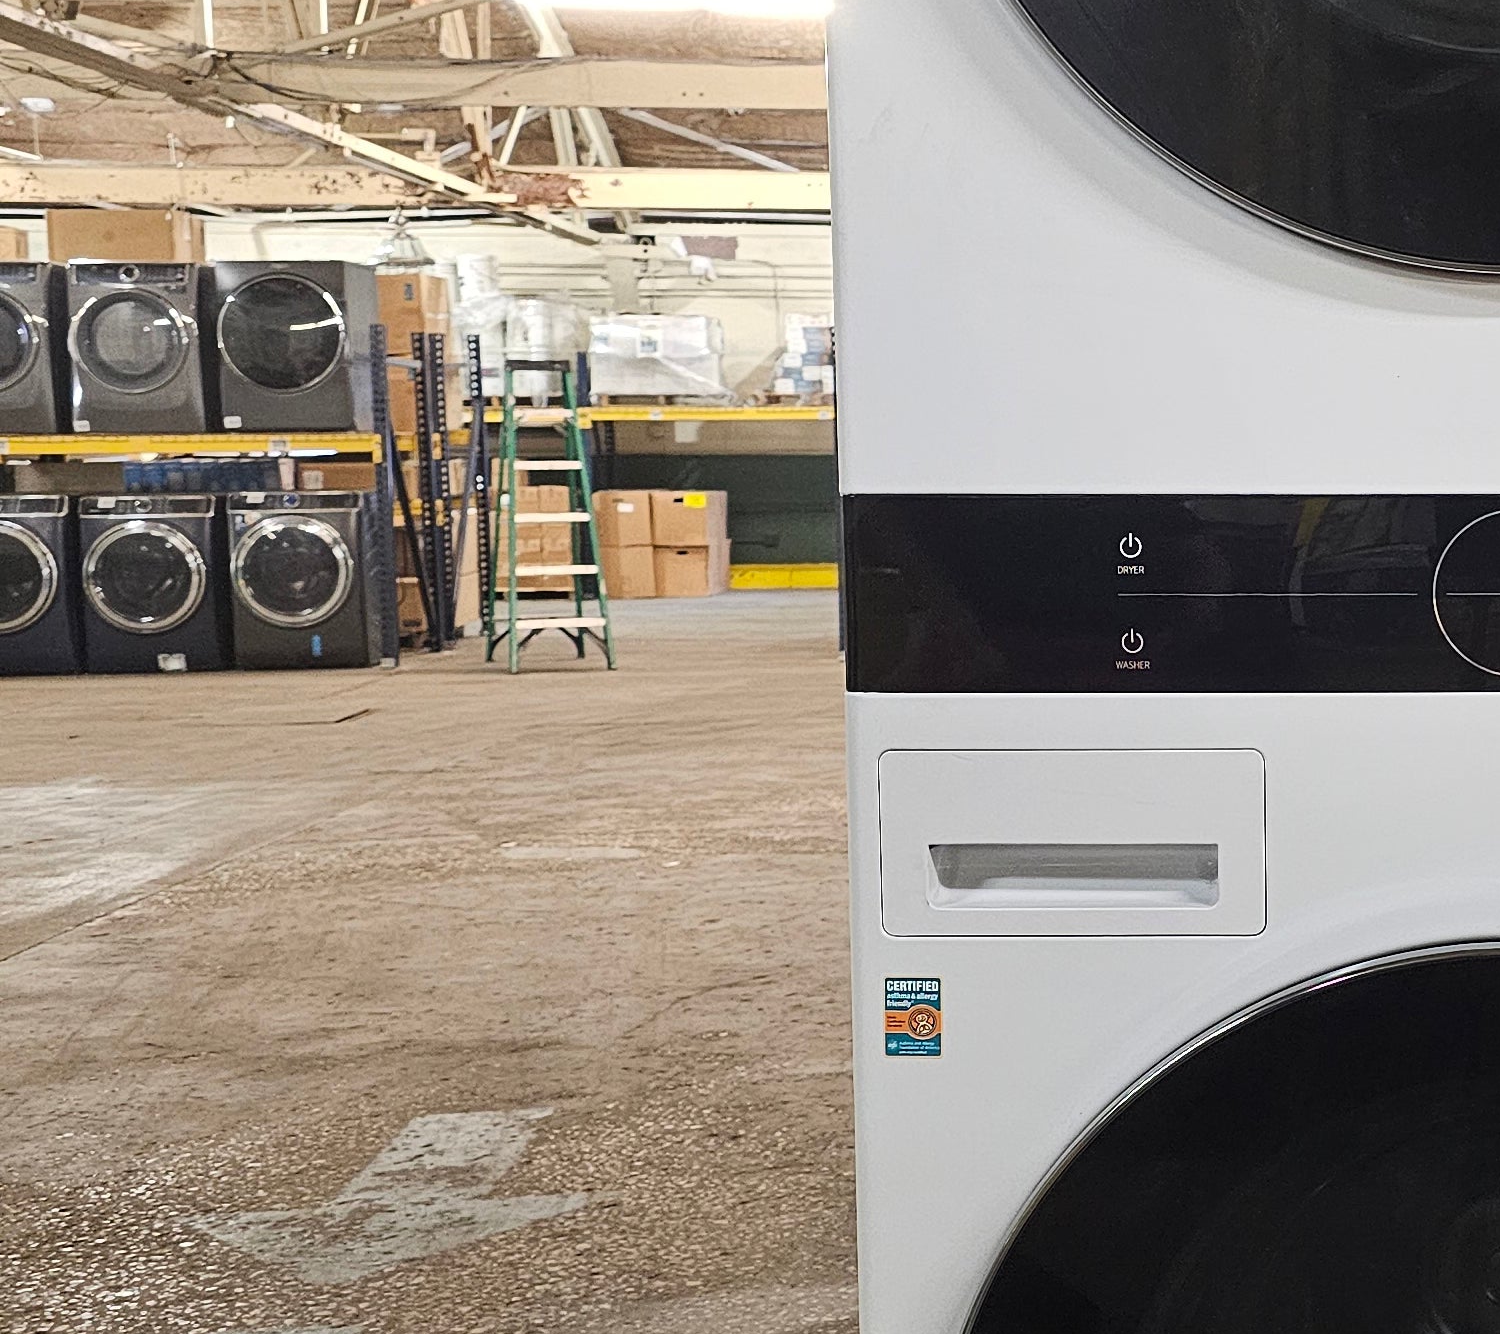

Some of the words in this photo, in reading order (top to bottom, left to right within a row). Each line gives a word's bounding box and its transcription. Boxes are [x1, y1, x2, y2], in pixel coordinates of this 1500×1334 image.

[1117, 565, 1145, 575] DRYER
[1115, 660, 1151, 670] WASHER
[886, 980, 939, 992] CERTIFIED
